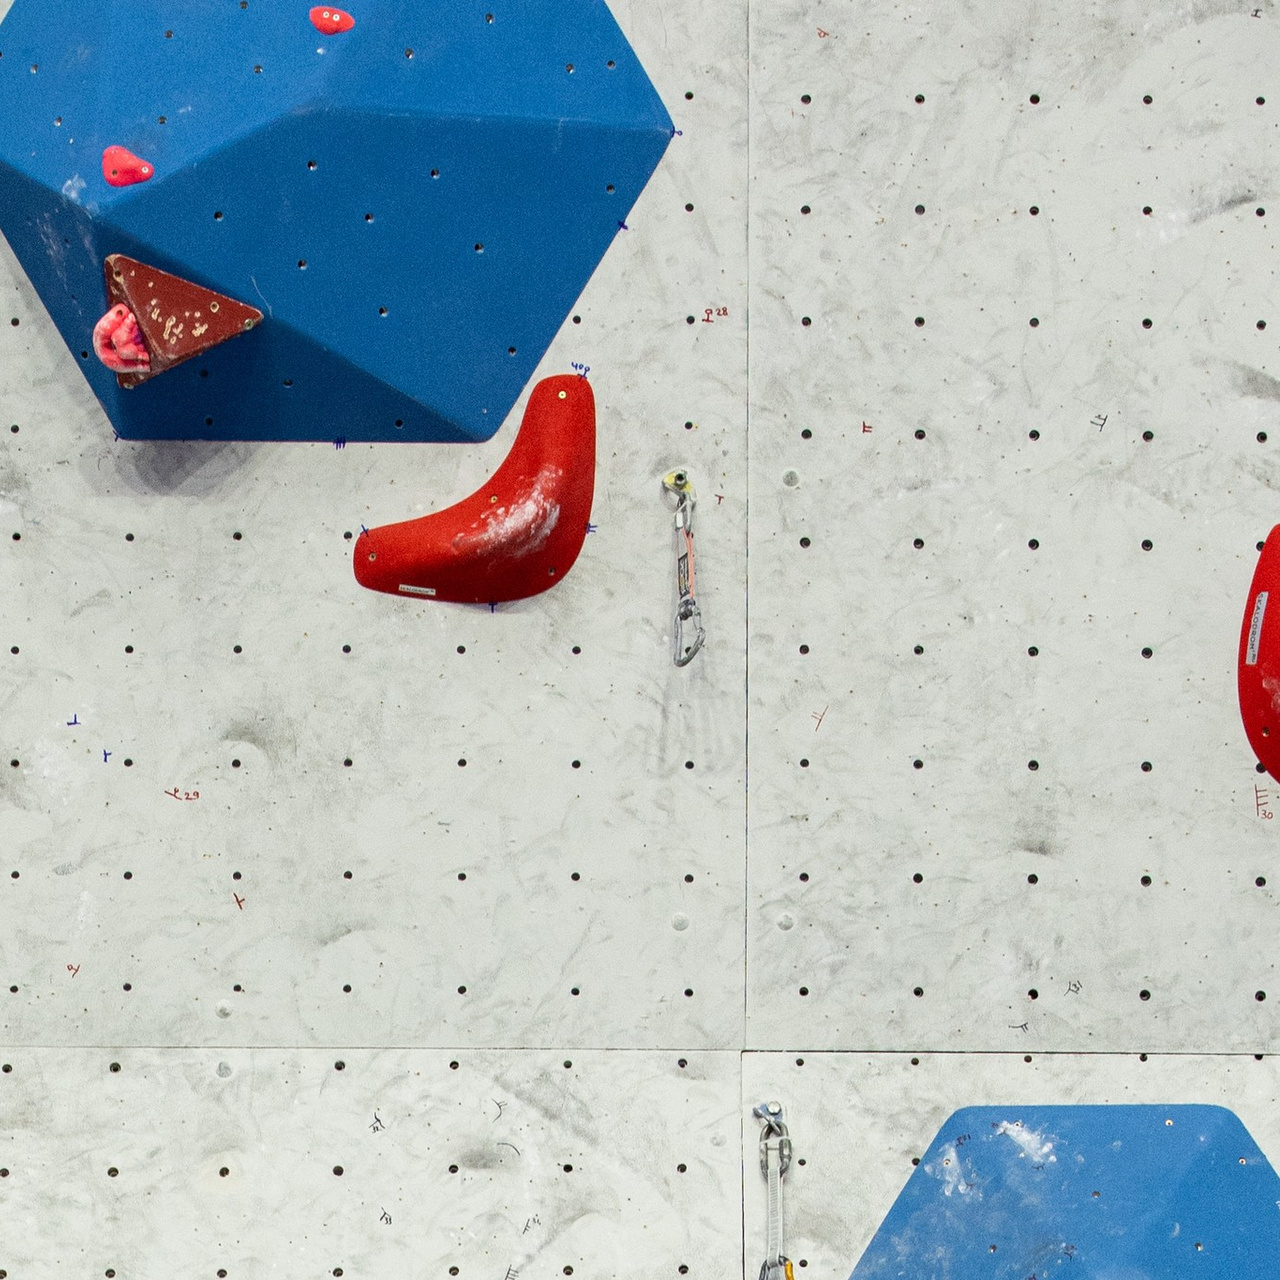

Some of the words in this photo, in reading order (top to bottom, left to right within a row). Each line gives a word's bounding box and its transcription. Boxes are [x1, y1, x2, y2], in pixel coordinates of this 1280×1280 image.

[715, 306, 729, 317] 28
[184, 791, 200, 801] 29
[1261, 809, 1274, 820] 30
